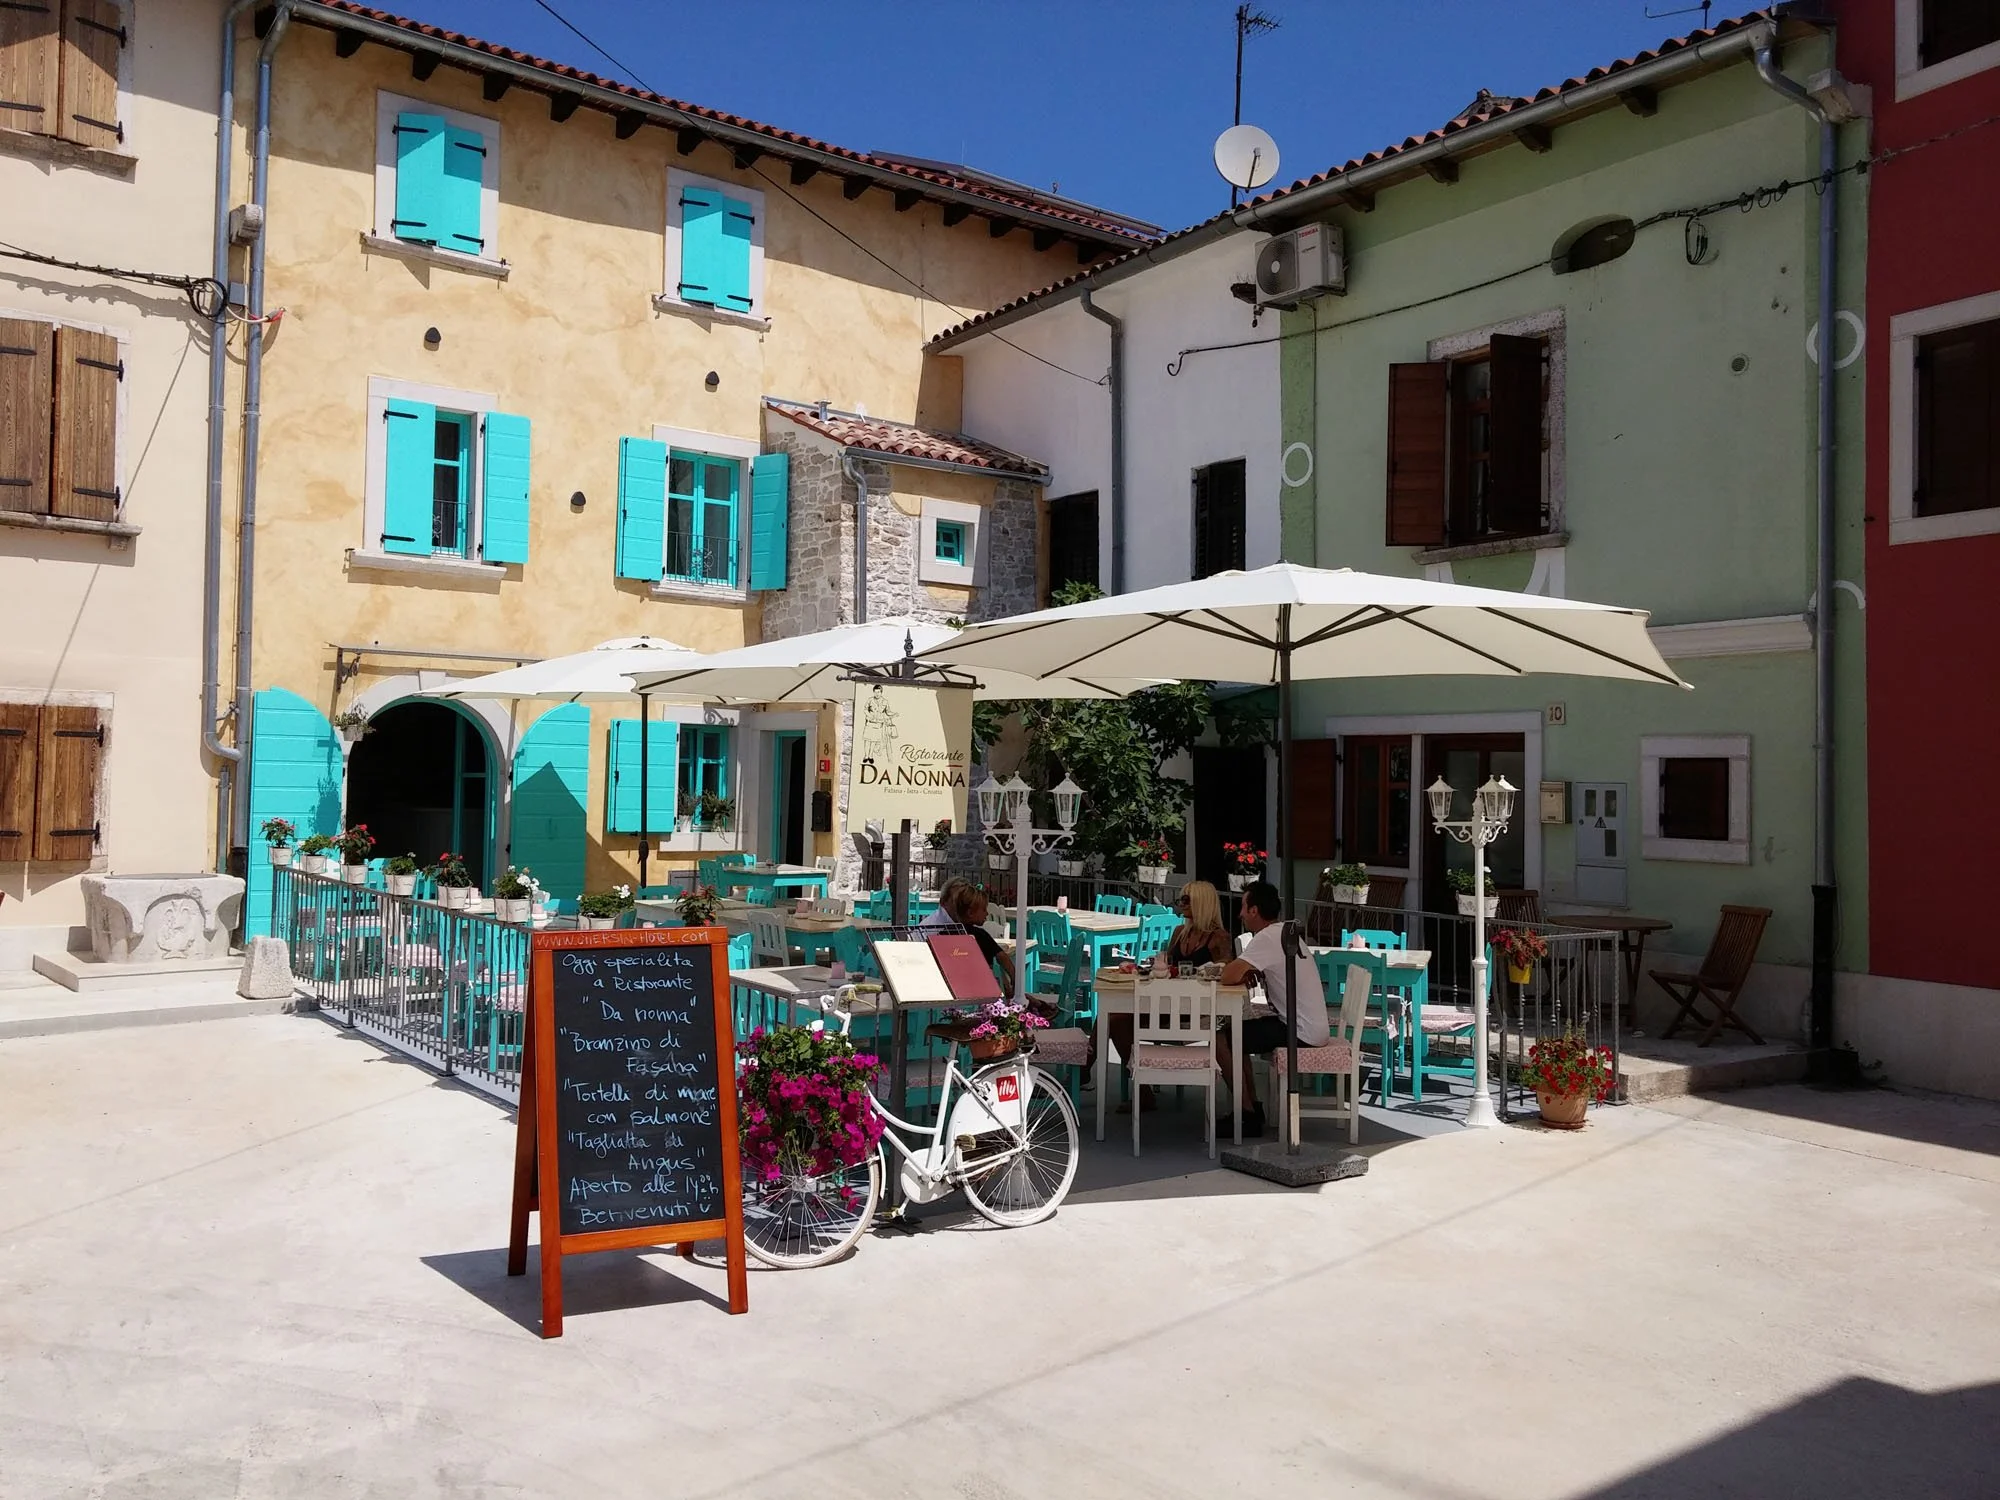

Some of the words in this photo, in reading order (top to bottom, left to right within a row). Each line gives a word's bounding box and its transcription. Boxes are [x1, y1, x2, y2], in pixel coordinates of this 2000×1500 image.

[1549, 706, 1562, 721] 10
[900, 744, 964, 763] Ristorante
[562, 953, 598, 975] Oggi
[593, 978, 605, 988] a
[612, 972, 694, 992] Ristorante
[660, 1029, 682, 1048] di
[644, 1082, 669, 1101] di
[677, 1086, 716, 1102] mare
[999, 1079, 1016, 1099] illy
[587, 1111, 617, 1124] con
[664, 1131, 684, 1149] di
[570, 1174, 632, 1203] Aperto
[642, 1174, 677, 1194] alle
